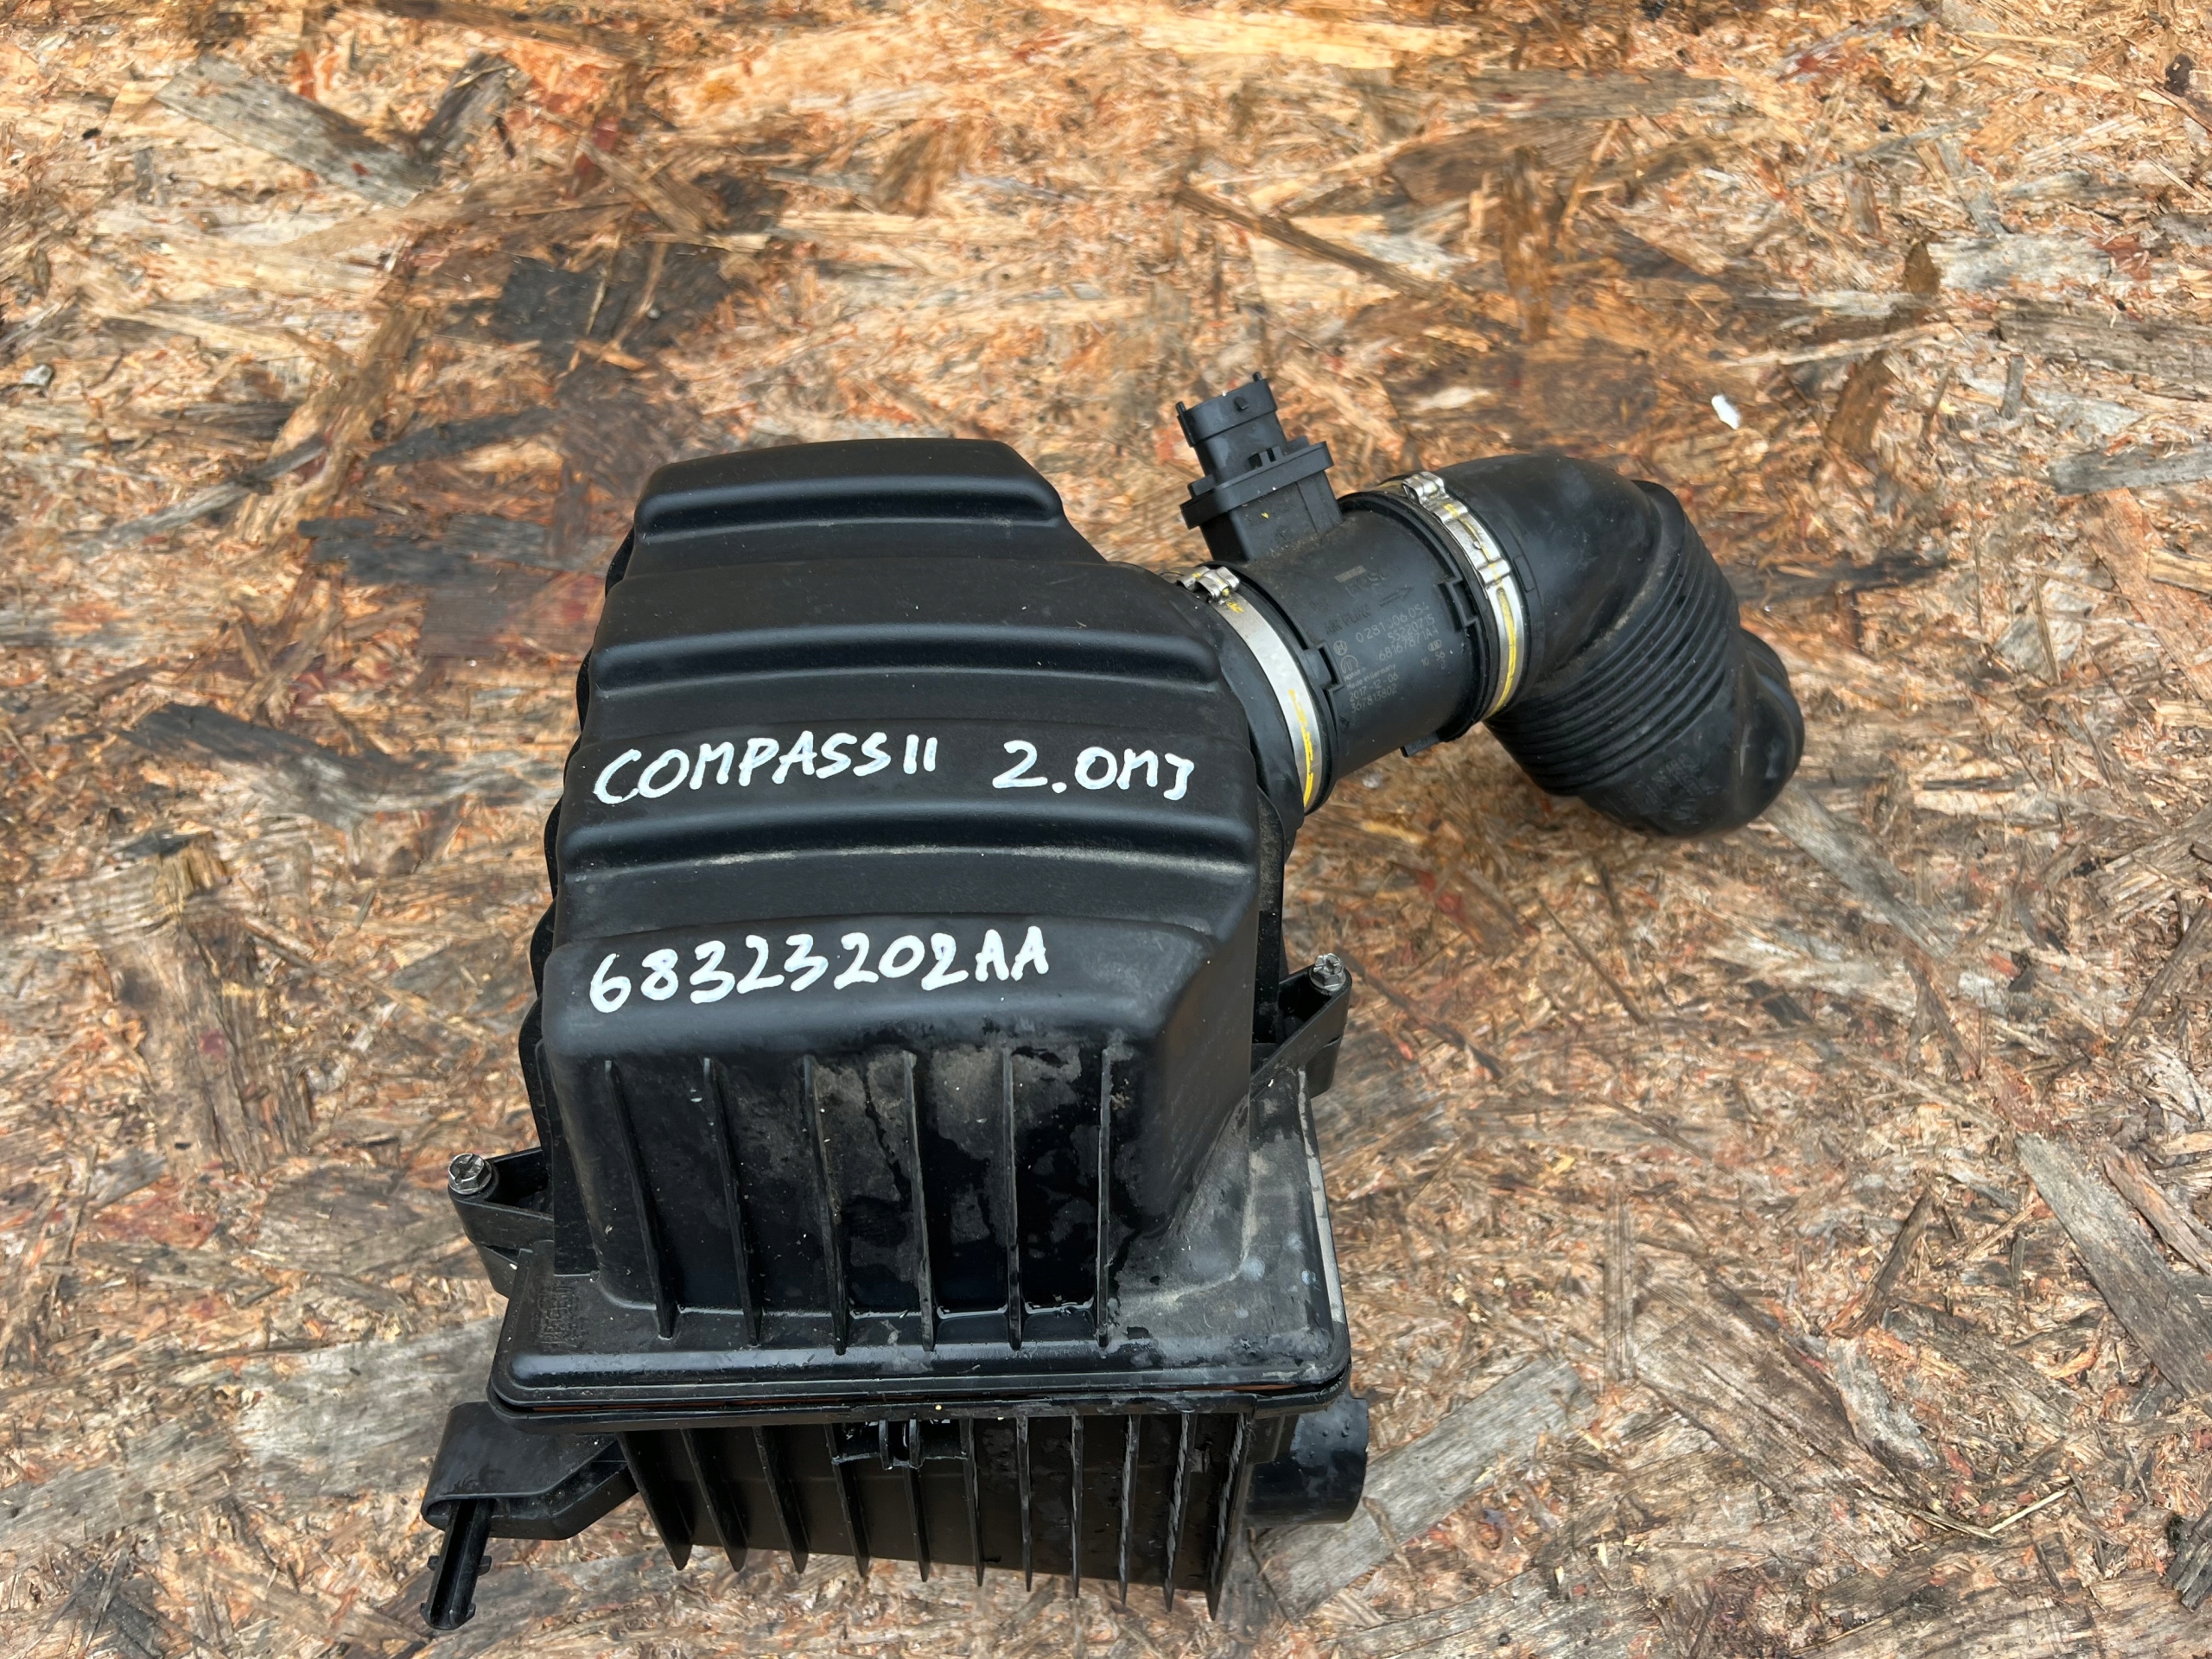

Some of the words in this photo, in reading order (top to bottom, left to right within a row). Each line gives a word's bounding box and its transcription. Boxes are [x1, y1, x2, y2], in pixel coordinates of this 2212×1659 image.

[1355, 632, 1364, 643] 0
[1363, 620, 1386, 640] 281
[1379, 626, 1439, 662] 68167871AA
[1387, 613, 1435, 644] 55220715
[1346, 678, 1363, 690] Made
[1370, 663, 1396, 680] Germany
[1351, 683, 1397, 714] 367813802
[589, 925, 1051, 1014] 68323202AA
